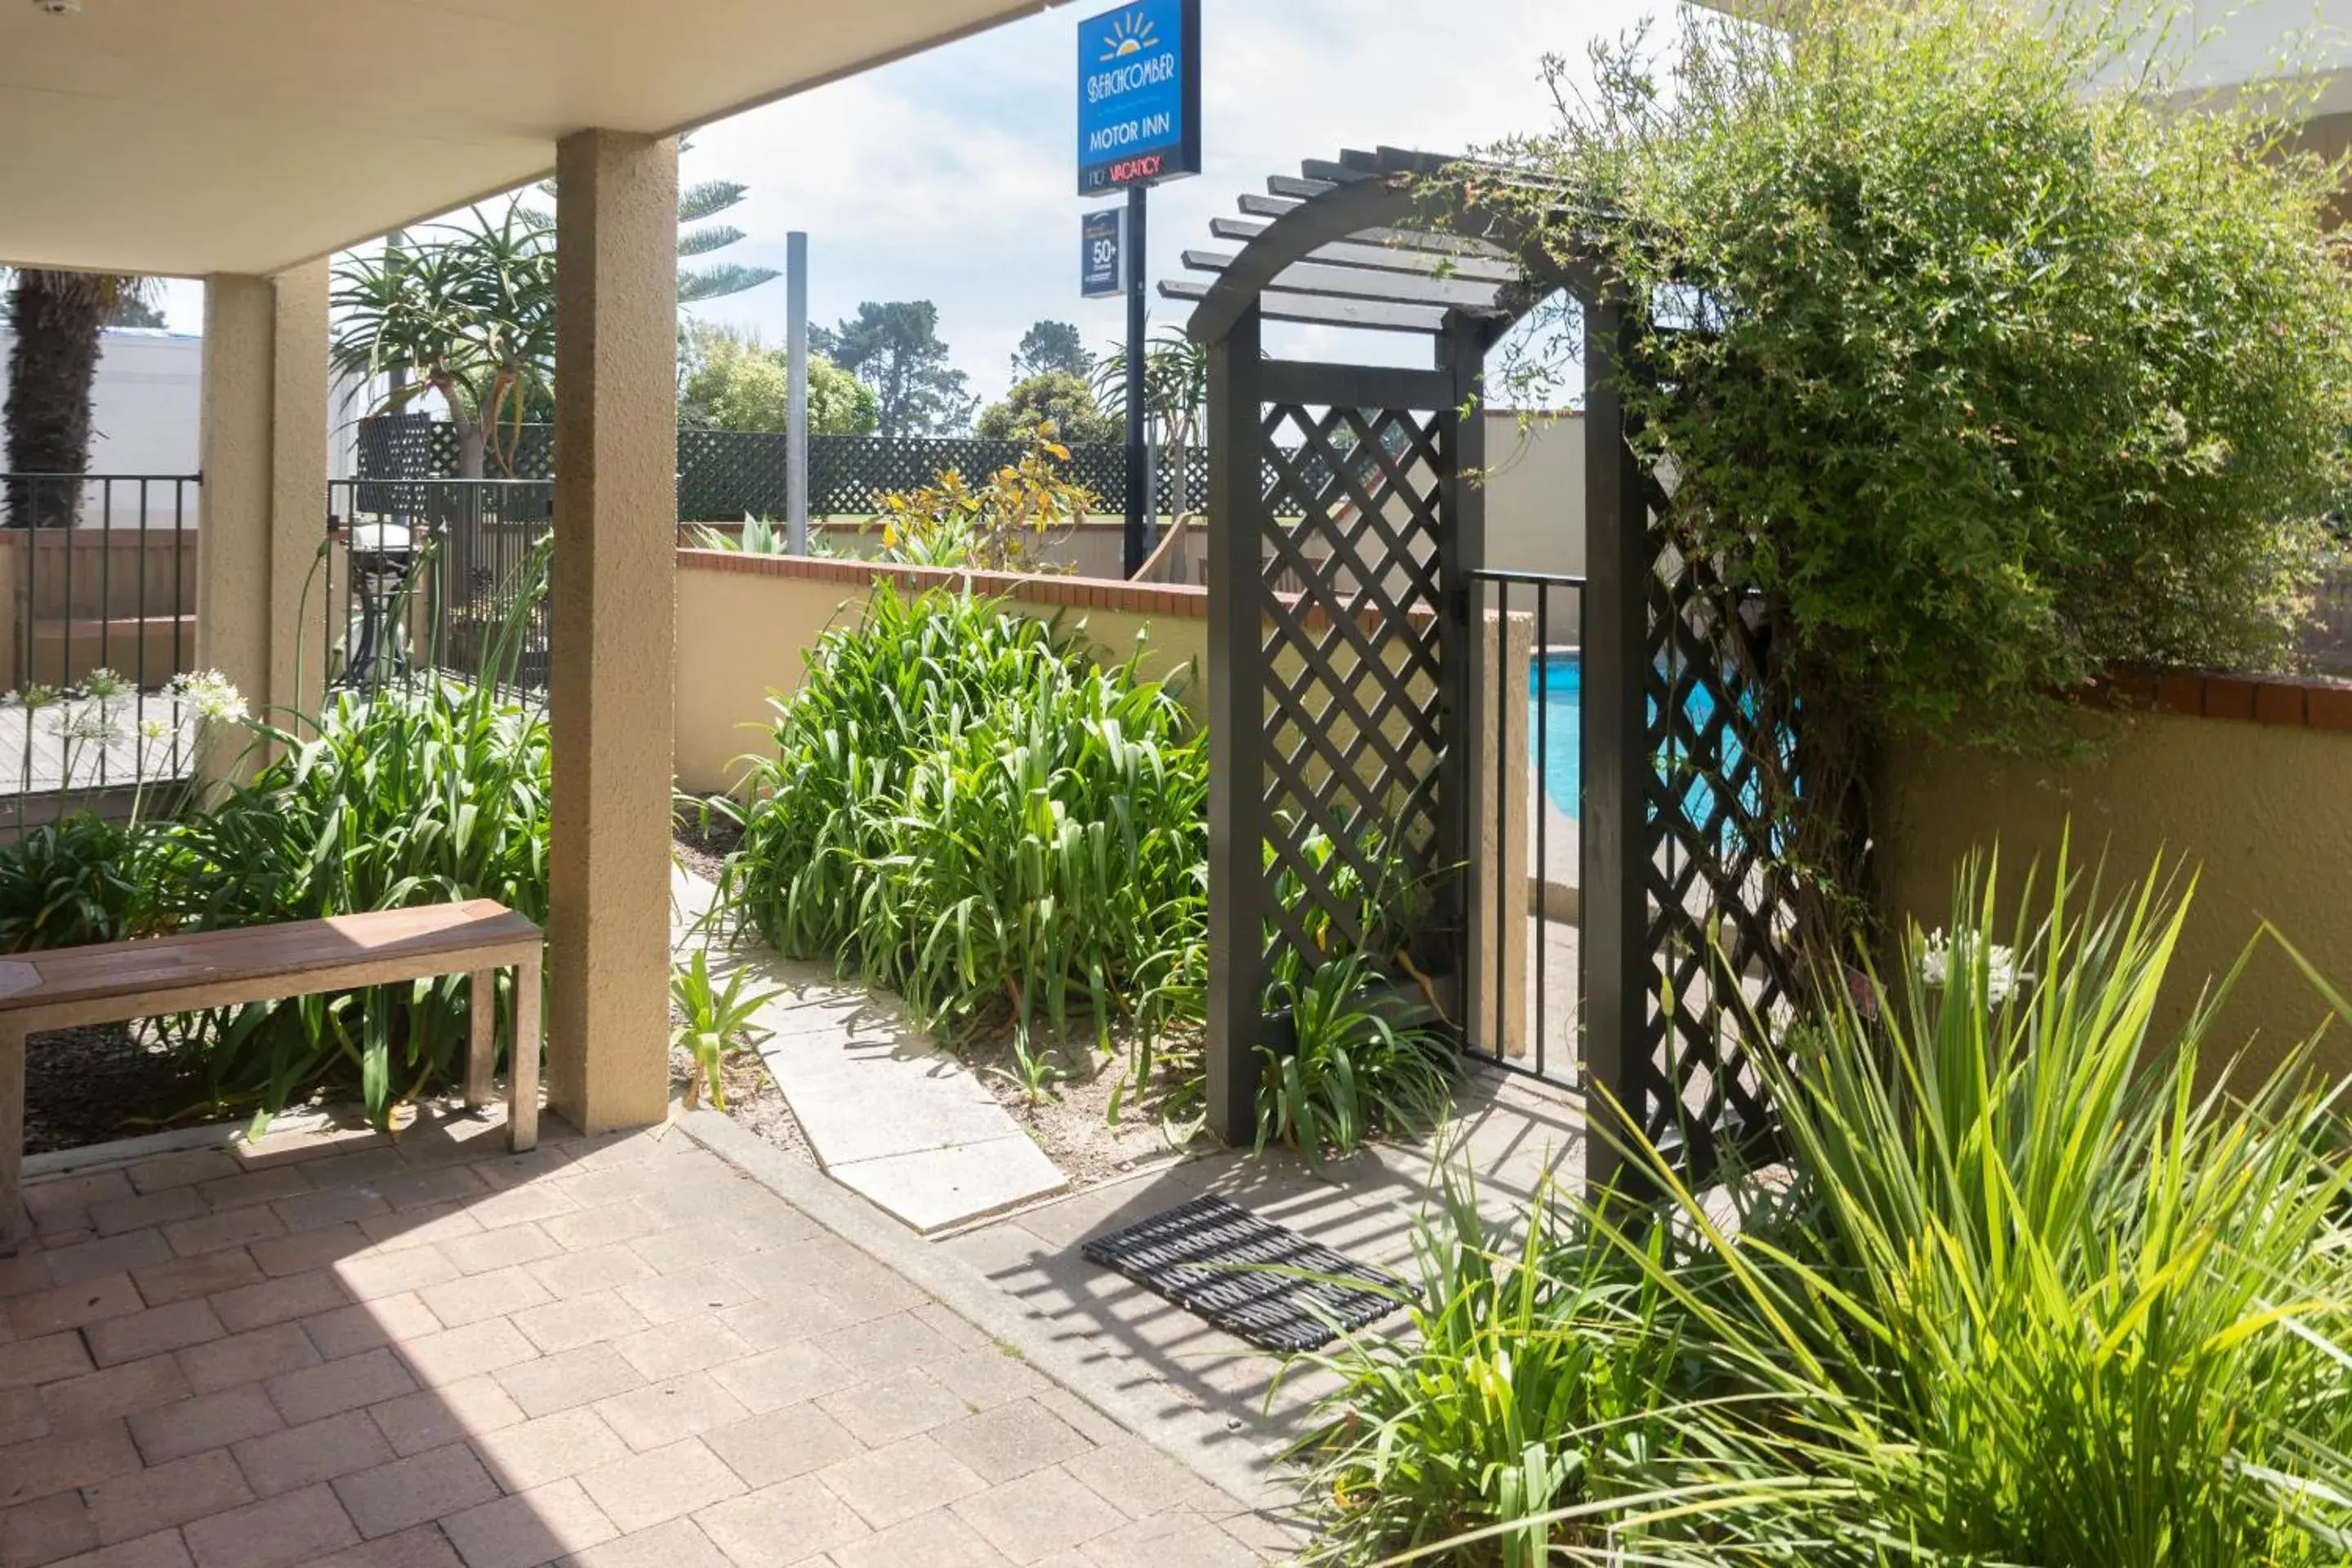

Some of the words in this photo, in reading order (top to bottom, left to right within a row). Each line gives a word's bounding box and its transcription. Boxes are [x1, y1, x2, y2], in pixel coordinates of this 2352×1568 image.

[1087, 53, 1174, 102] BEACHCOMBER
[1090, 120, 1138, 152] MOTOR
[1143, 112, 1170, 139] INN
[1109, 156, 1162, 181] VACANCY
